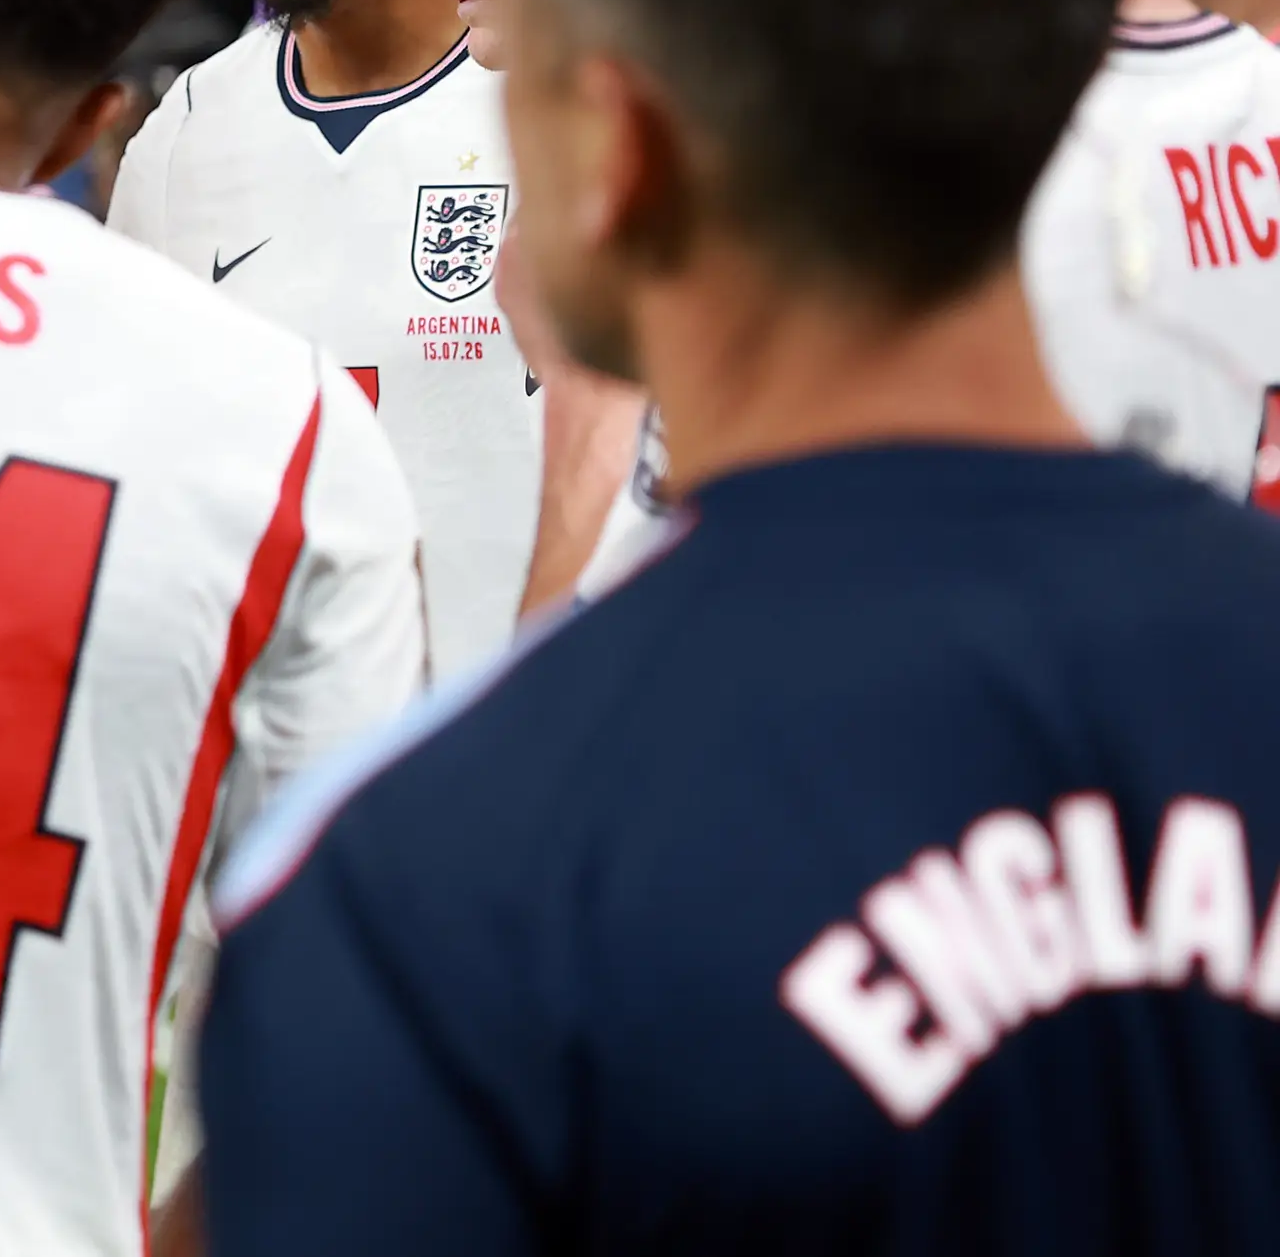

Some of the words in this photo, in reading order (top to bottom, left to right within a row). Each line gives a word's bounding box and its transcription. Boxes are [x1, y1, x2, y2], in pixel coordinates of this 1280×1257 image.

[406, 316, 502, 336] ARGENTINA
[422, 342, 484, 361] 15.07.26
[778, 788, 1280, 1131] ENGLA
